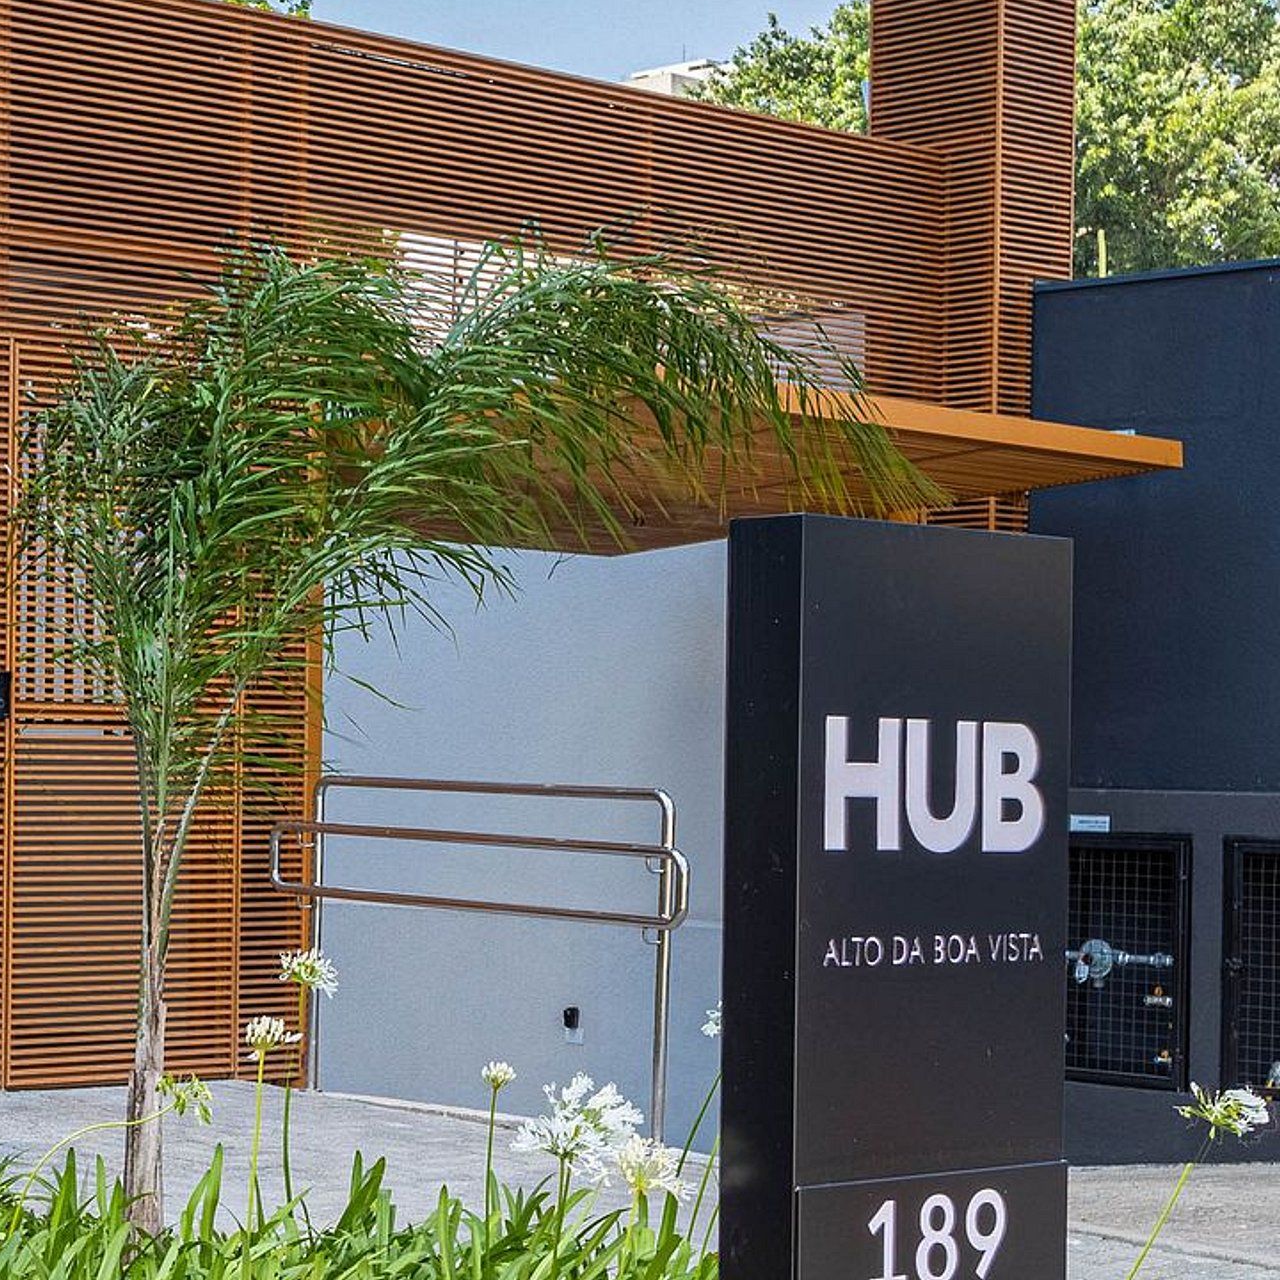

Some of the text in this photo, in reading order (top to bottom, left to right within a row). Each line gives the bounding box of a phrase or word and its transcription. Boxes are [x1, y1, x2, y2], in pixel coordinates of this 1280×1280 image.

[824, 716, 1044, 852] HUB
[823, 933, 1043, 966] ALTO DA BOA VISTA
